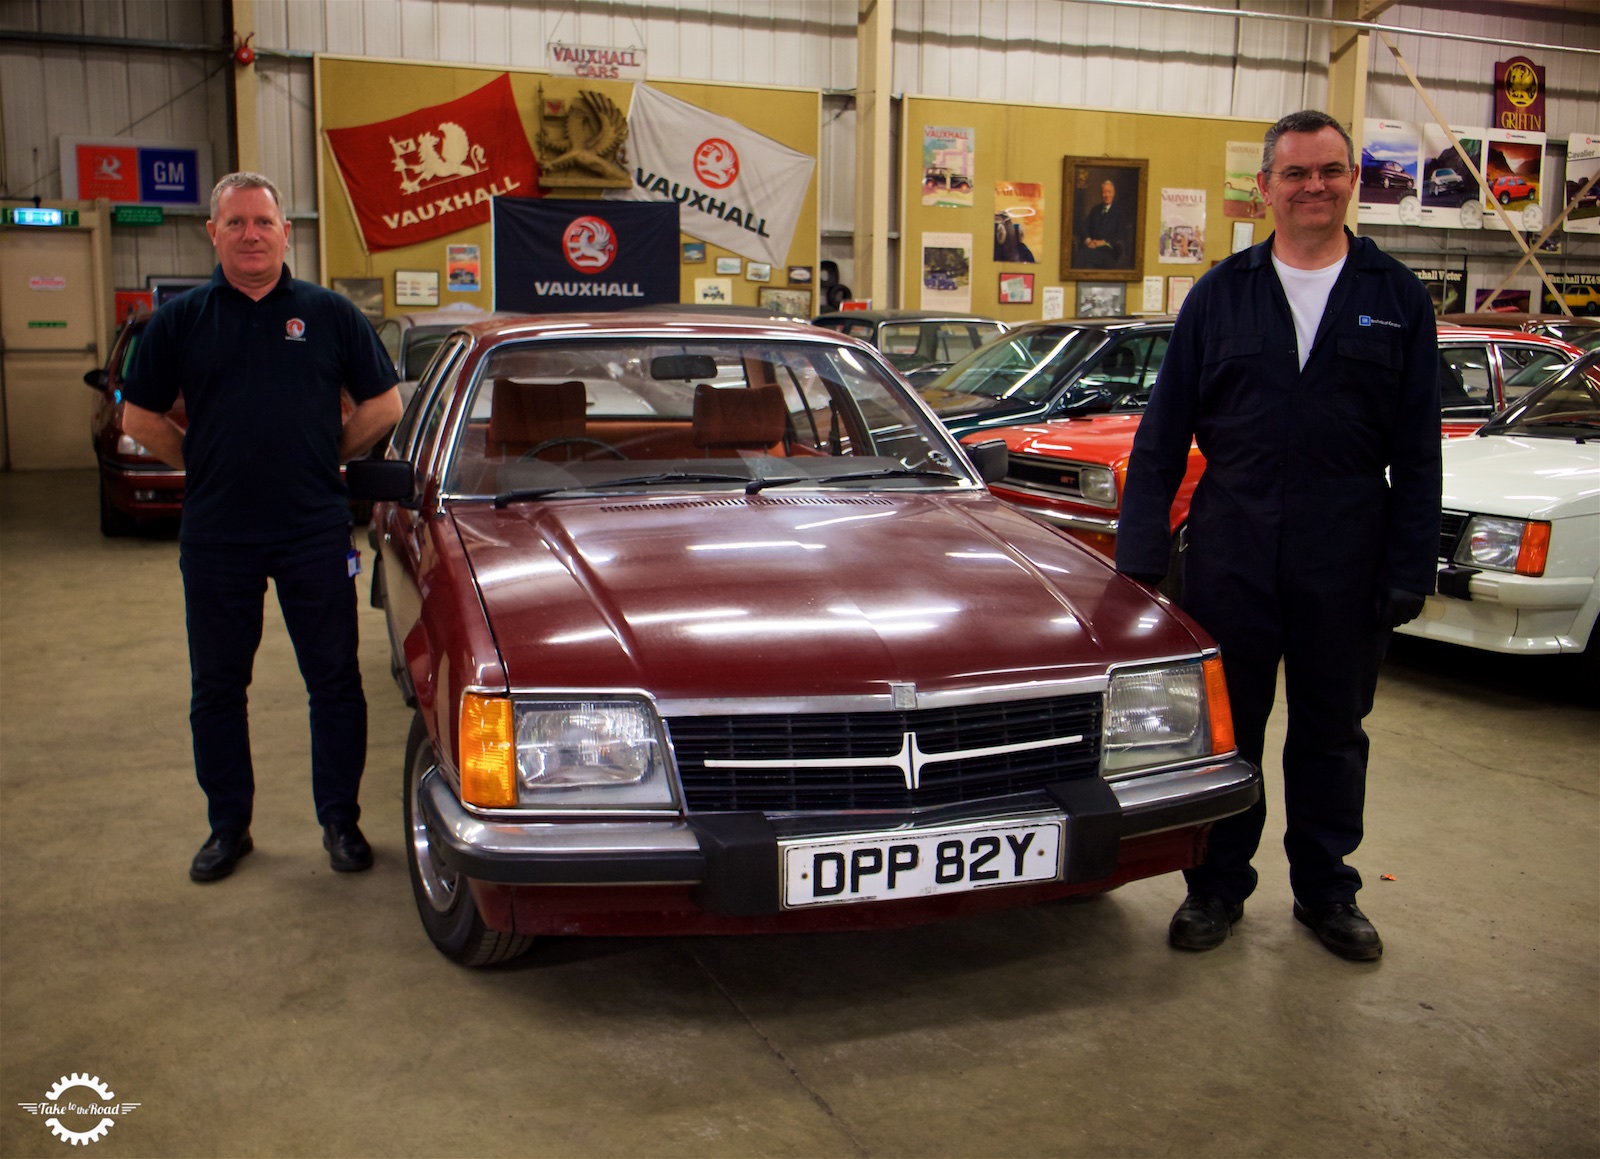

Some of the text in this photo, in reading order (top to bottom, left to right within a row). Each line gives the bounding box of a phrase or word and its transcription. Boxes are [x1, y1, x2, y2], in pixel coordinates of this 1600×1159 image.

[553, 46, 641, 67] VAUXHALL
[575, 64, 620, 80] CARS
[924, 129, 969, 140] VAUXHALL
[1567, 149, 1595, 159] Cavalier
[153, 160, 185, 184] GM
[382, 176, 521, 230] VAUXHALL
[637, 167, 770, 239] VAUXHALL
[534, 281, 645, 297] VAUXHALL
[1060, 475, 1076, 484] GT
[813, 832, 1037, 898] DPP 82Y
